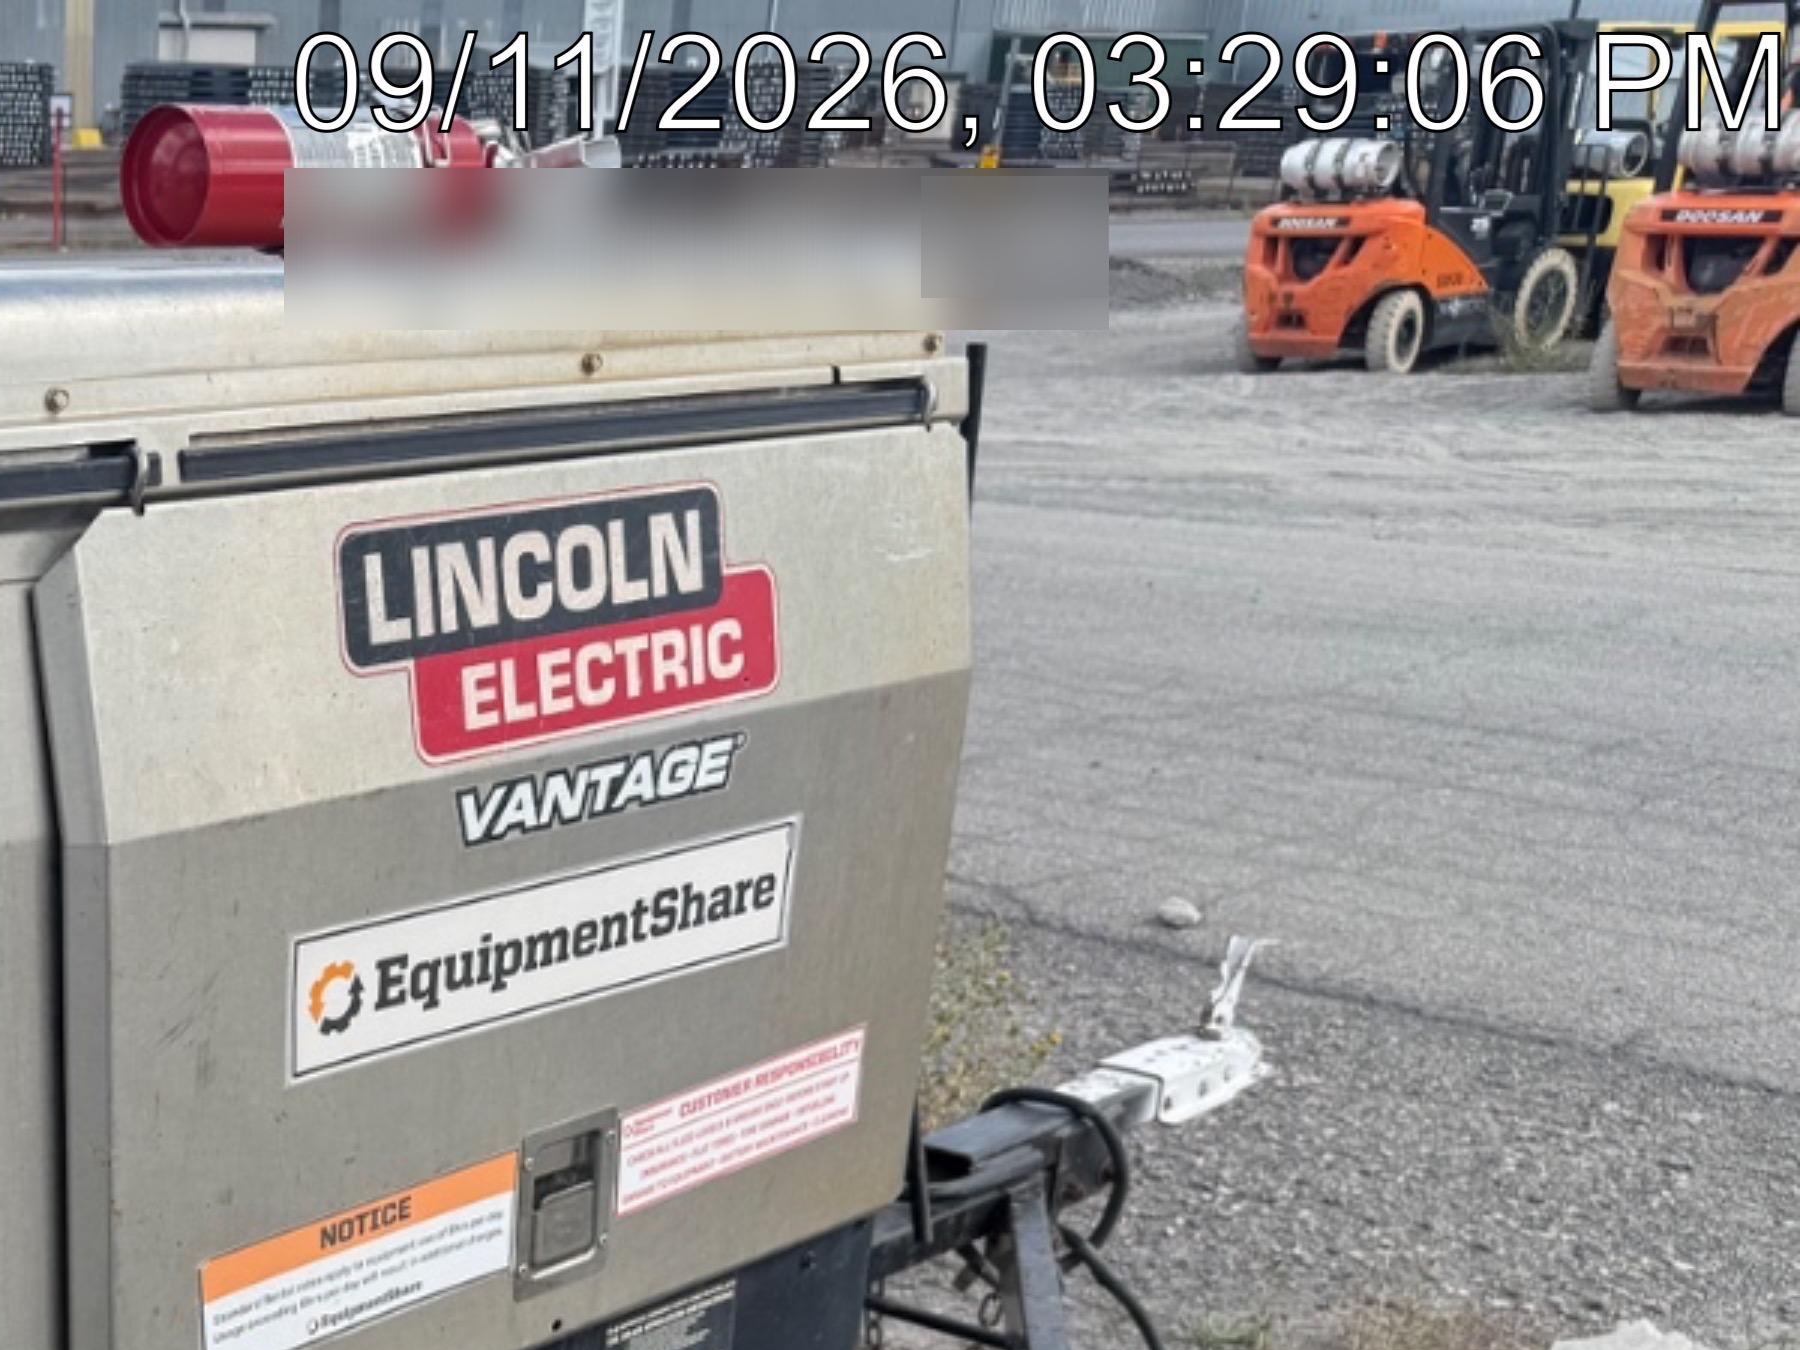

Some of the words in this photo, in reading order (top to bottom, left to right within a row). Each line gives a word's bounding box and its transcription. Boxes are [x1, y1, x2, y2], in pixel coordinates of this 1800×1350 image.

[1674, 208, 1766, 224] DOOSAN
[363, 508, 705, 647] LINCOLN
[461, 616, 745, 733] ELECTRIC
[457, 733, 740, 848] VANTAGE
[373, 871, 777, 1013] EquipmentShare
[679, 1077, 753, 1119] CUSTOMER
[755, 1039, 860, 1088] RESPONSIBILITY
[320, 1196, 412, 1250] NOTICE
